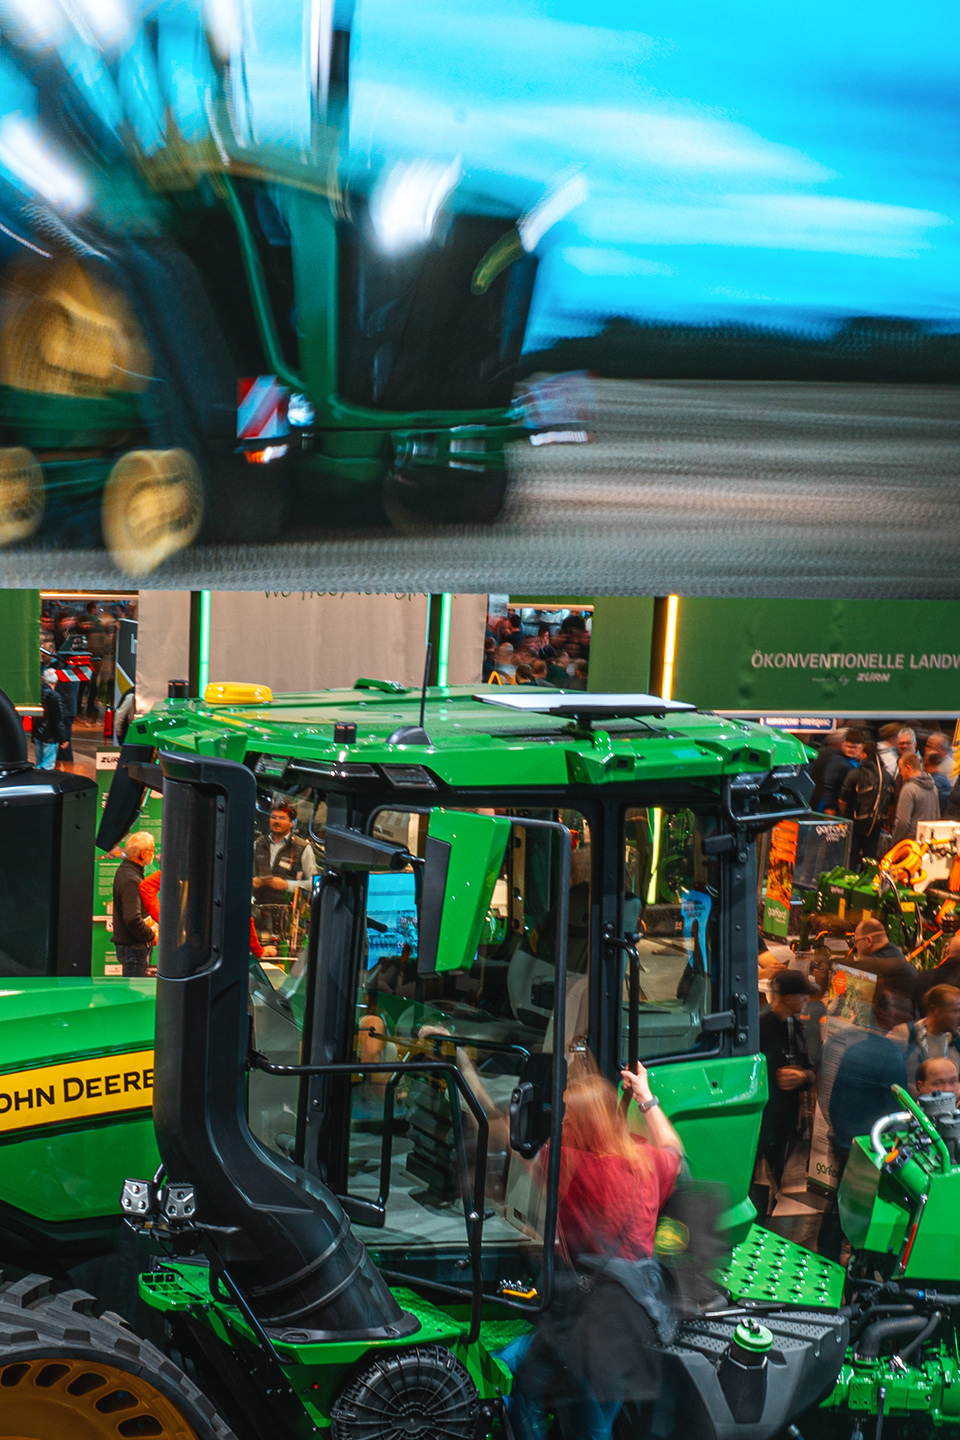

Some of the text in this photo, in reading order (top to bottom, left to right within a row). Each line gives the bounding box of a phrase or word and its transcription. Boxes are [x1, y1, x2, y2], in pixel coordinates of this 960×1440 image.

[750, 650, 906, 670] ÖKONVENTIONELLE
[856, 671, 891, 683] ZÜRN
[62, 1068, 155, 1103] DEERE
